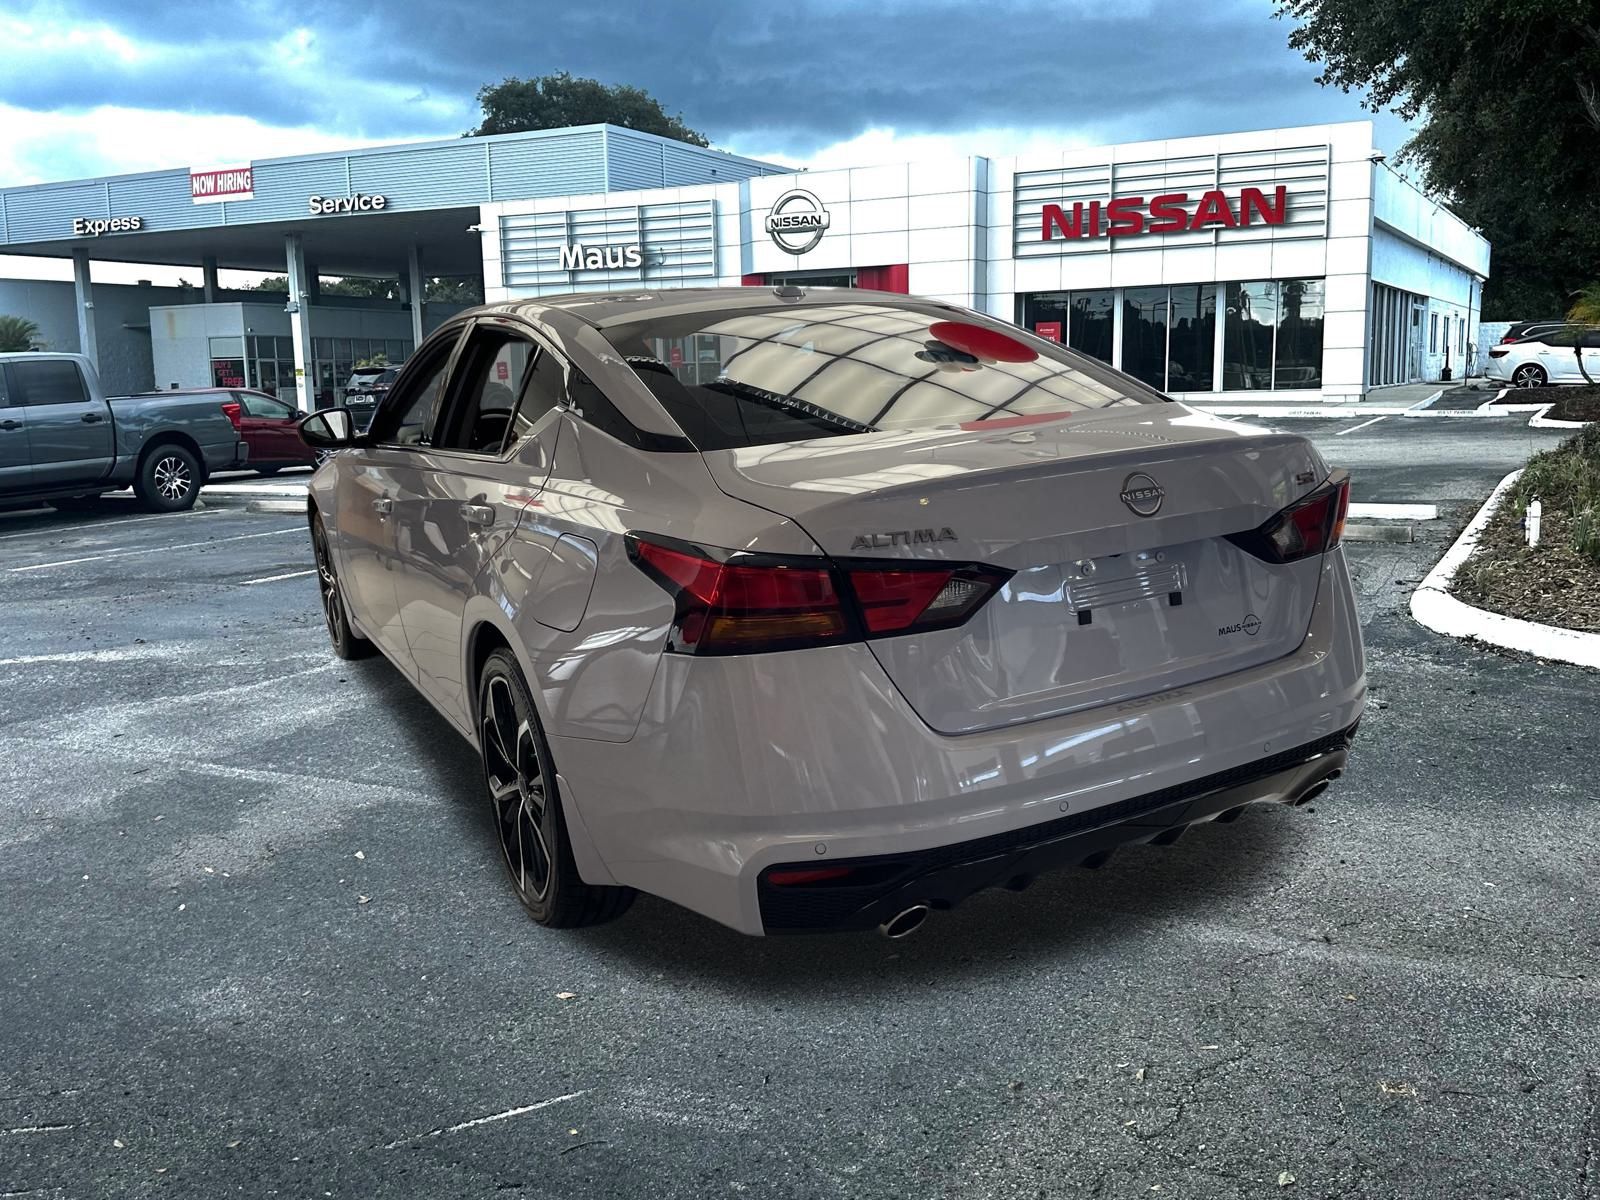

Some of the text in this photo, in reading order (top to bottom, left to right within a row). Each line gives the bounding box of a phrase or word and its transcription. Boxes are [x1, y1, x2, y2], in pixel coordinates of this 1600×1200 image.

[192, 171, 251, 195] NOW HIRING
[309, 192, 386, 215] Service
[1042, 185, 1287, 241] NISSAN
[73, 215, 142, 238] Express
[770, 214, 822, 229] NISSAN
[559, 243, 642, 270] Maus
[222, 377, 244, 386] FREE
[1121, 488, 1165, 501] NISSAN
[850, 527, 959, 550] ALTIMA
[1218, 623, 1241, 636] MAUS
